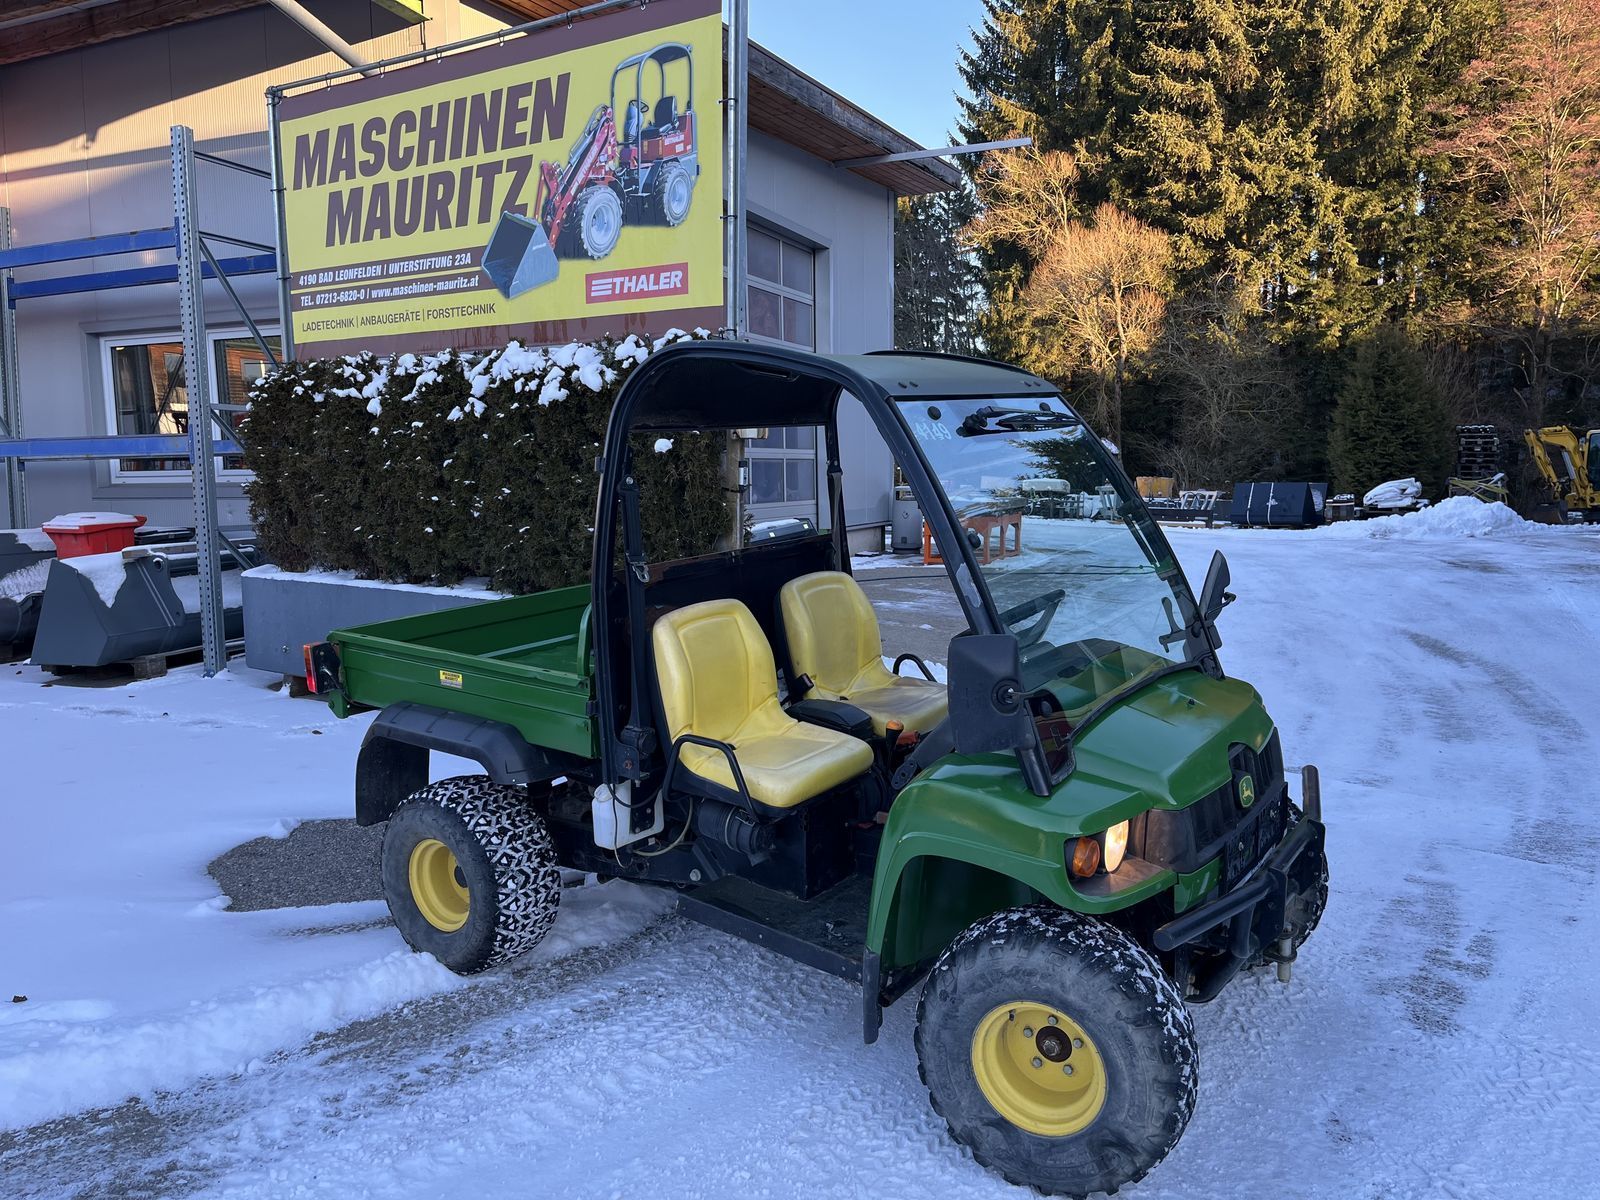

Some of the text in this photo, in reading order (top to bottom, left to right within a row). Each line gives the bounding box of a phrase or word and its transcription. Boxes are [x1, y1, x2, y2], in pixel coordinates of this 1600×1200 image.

[293, 72, 571, 191] MASCHINEN
[325, 154, 533, 247] MAURITZ
[299, 252, 472, 286] 4190 BAD LEONFELDEN UNTERSTIFTUNG 23A
[613, 270, 683, 294] THALER
[300, 276, 480, 307] TEL. 07213-6820-0 www.maschinen-mauritz.at
[302, 303, 496, 332] LADETECHNIK ANBAUGERÄTE FORSTTECHNIK
